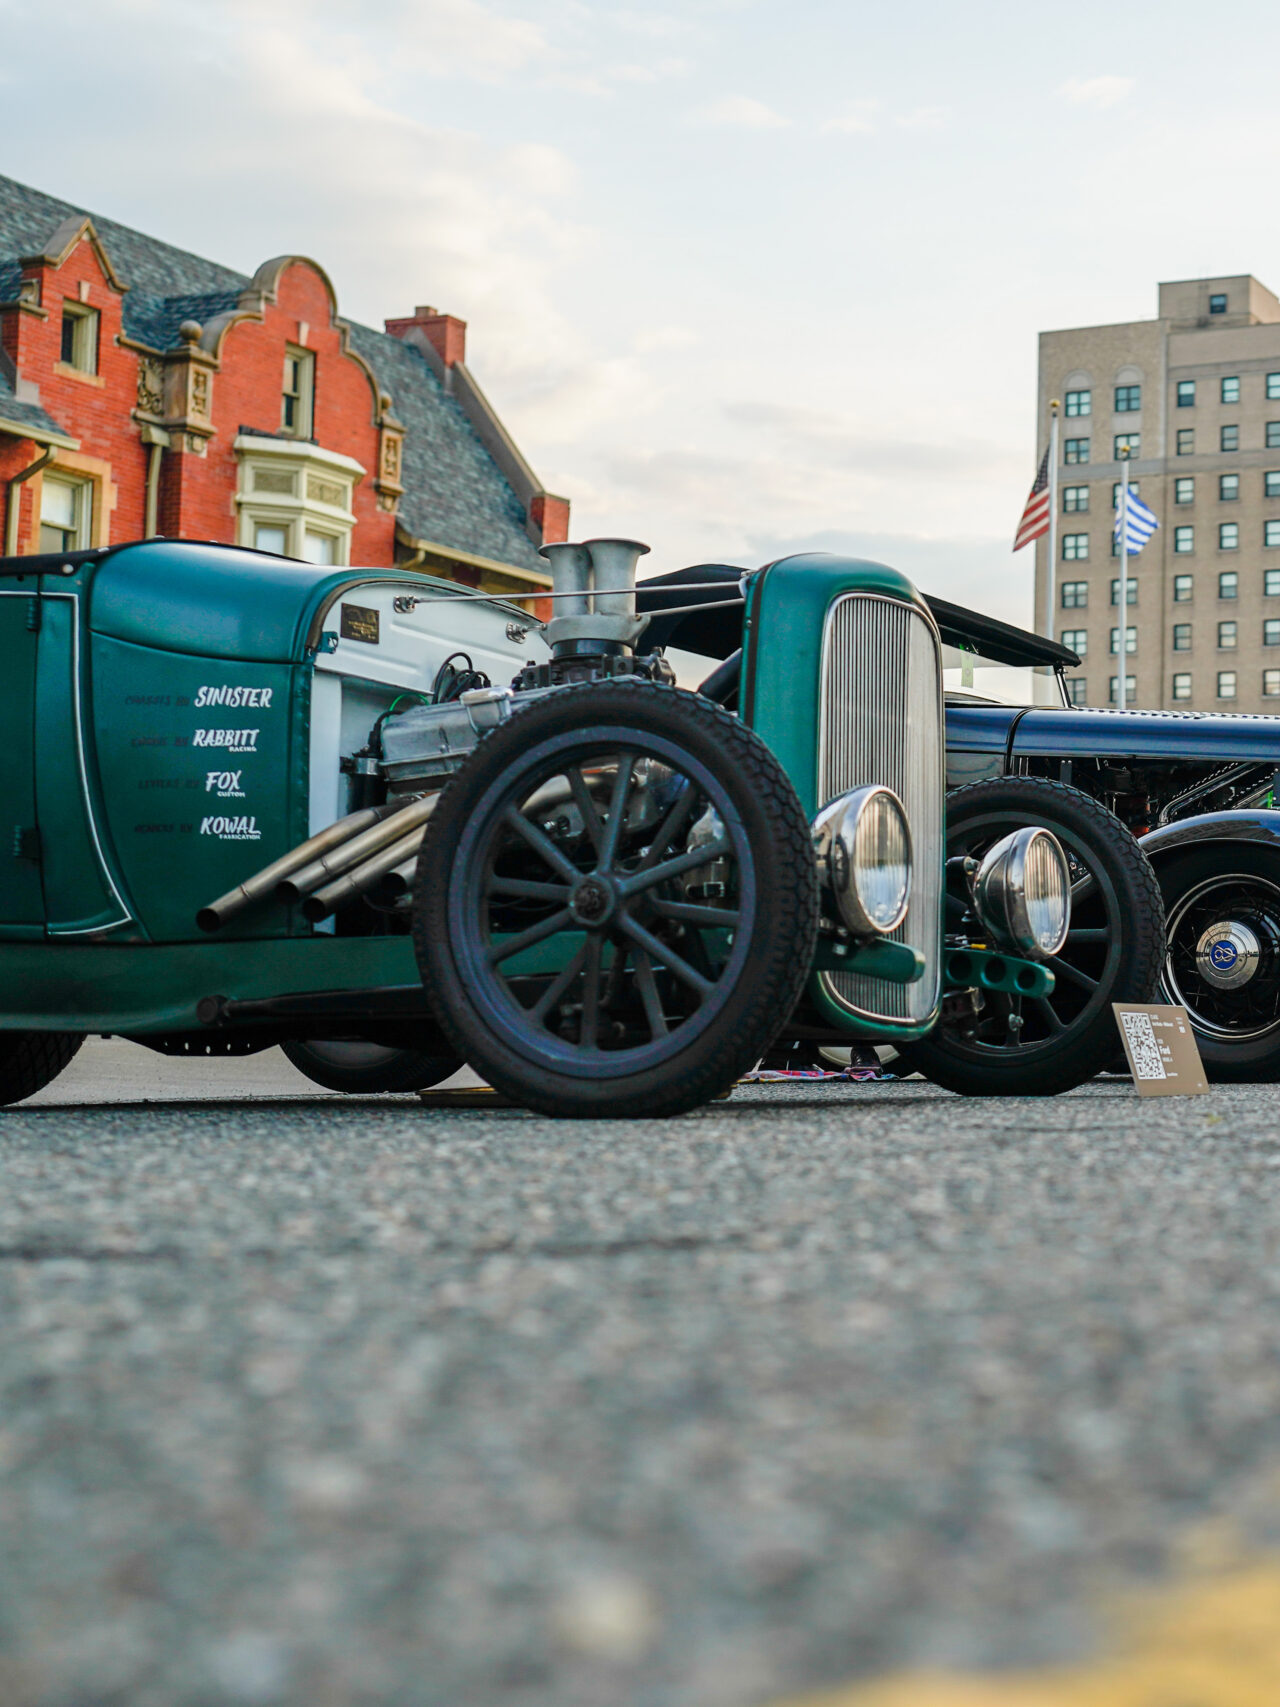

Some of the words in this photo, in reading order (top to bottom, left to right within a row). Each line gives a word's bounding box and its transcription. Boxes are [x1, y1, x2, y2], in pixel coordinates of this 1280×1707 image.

[194, 684, 273, 708] SINISTER
[192, 728, 260, 747] RABBITT
[205, 769, 243, 793] FOX
[200, 815, 262, 835] KOWAL
